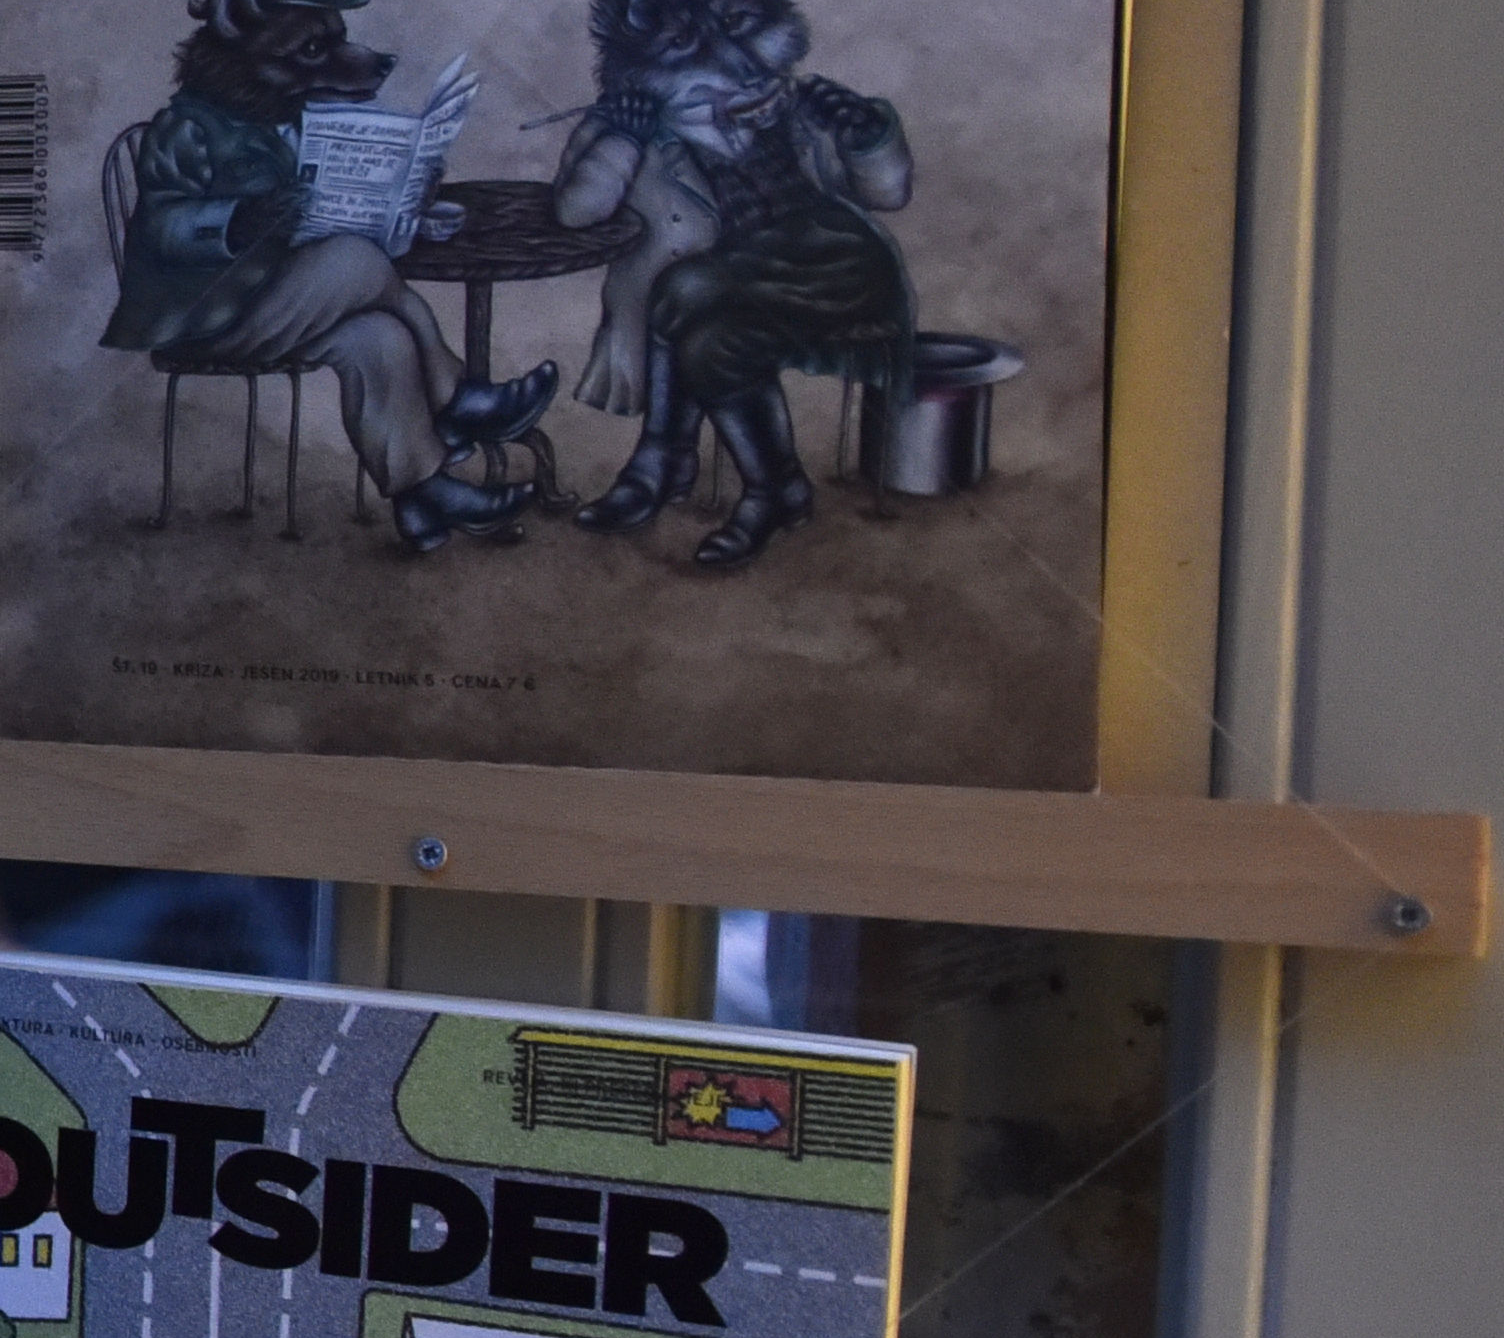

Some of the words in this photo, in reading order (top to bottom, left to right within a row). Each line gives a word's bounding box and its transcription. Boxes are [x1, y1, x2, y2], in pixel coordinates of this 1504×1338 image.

[241, 664, 294, 682] JESEN
[299, 667, 340, 683] 2019
[355, 669, 419, 687] LETNIK
[451, 674, 502, 690] CENA
